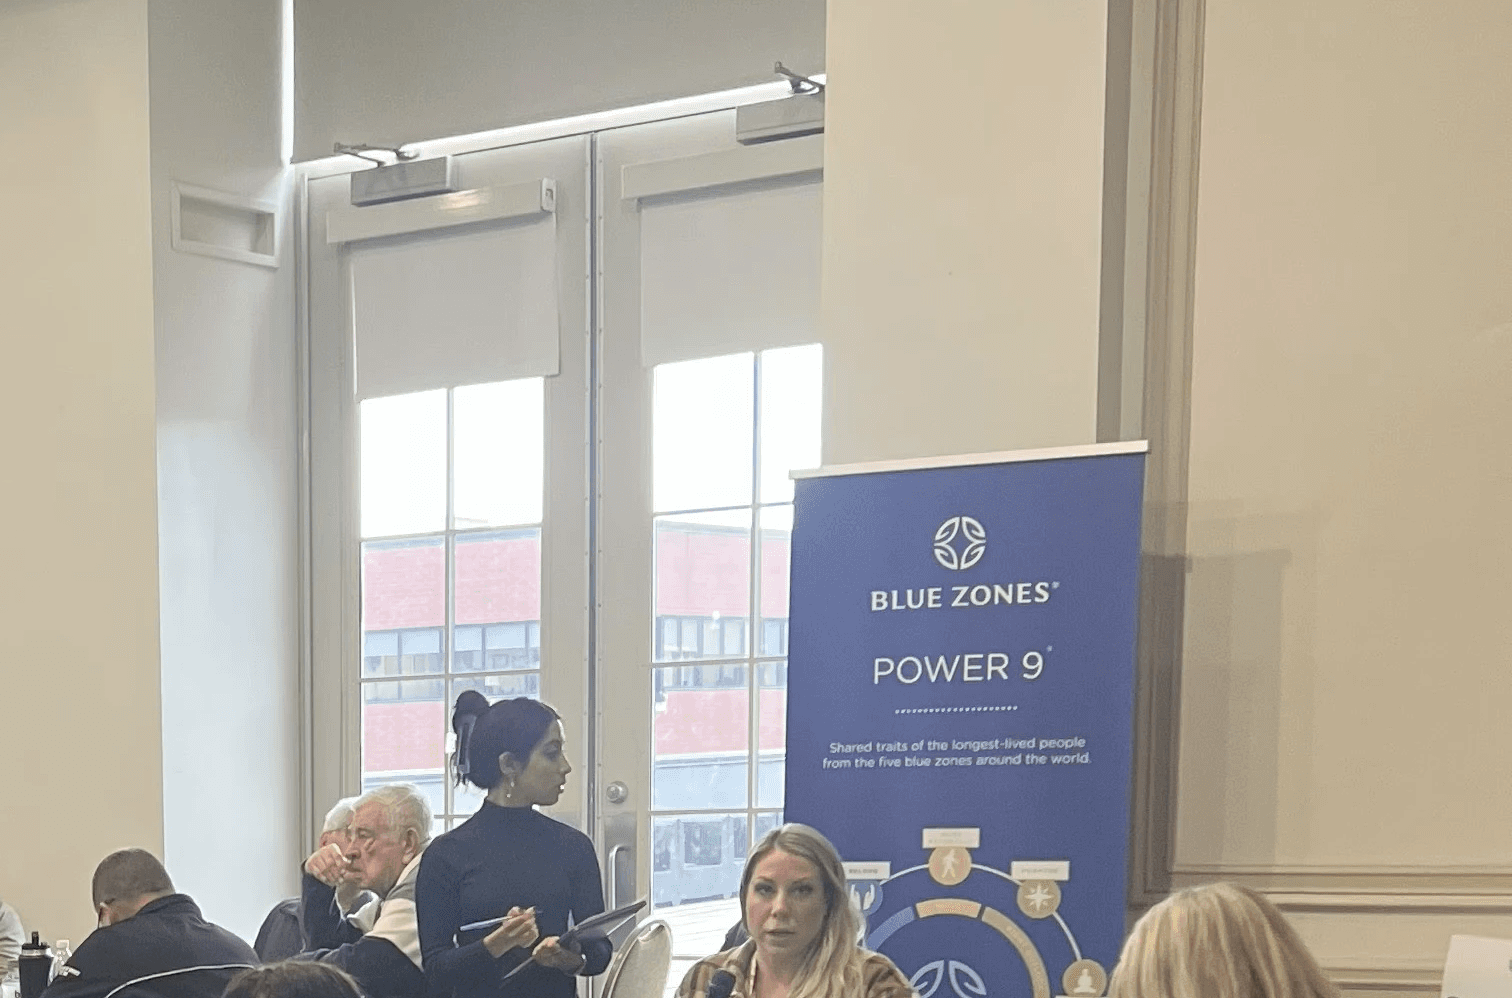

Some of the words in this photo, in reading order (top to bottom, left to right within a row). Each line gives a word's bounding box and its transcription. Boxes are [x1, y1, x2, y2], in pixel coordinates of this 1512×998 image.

[870, 587, 943, 611] BLUE
[873, 653, 1009, 685] POWER
[829, 742, 873, 754] Shared
[876, 741, 908, 753] traits
[911, 740, 925, 751] of
[927, 740, 948, 751] the
[951, 738, 1036, 752] longest-lived
[1039, 737, 1086, 750] people
[822, 758, 851, 769] from
[854, 757, 875, 768] the
[878, 756, 901, 768] five
[904, 756, 931, 767] blue
[934, 755, 973, 767] zones
[975, 753, 1022, 766] around
[1025, 753, 1048, 765] the
